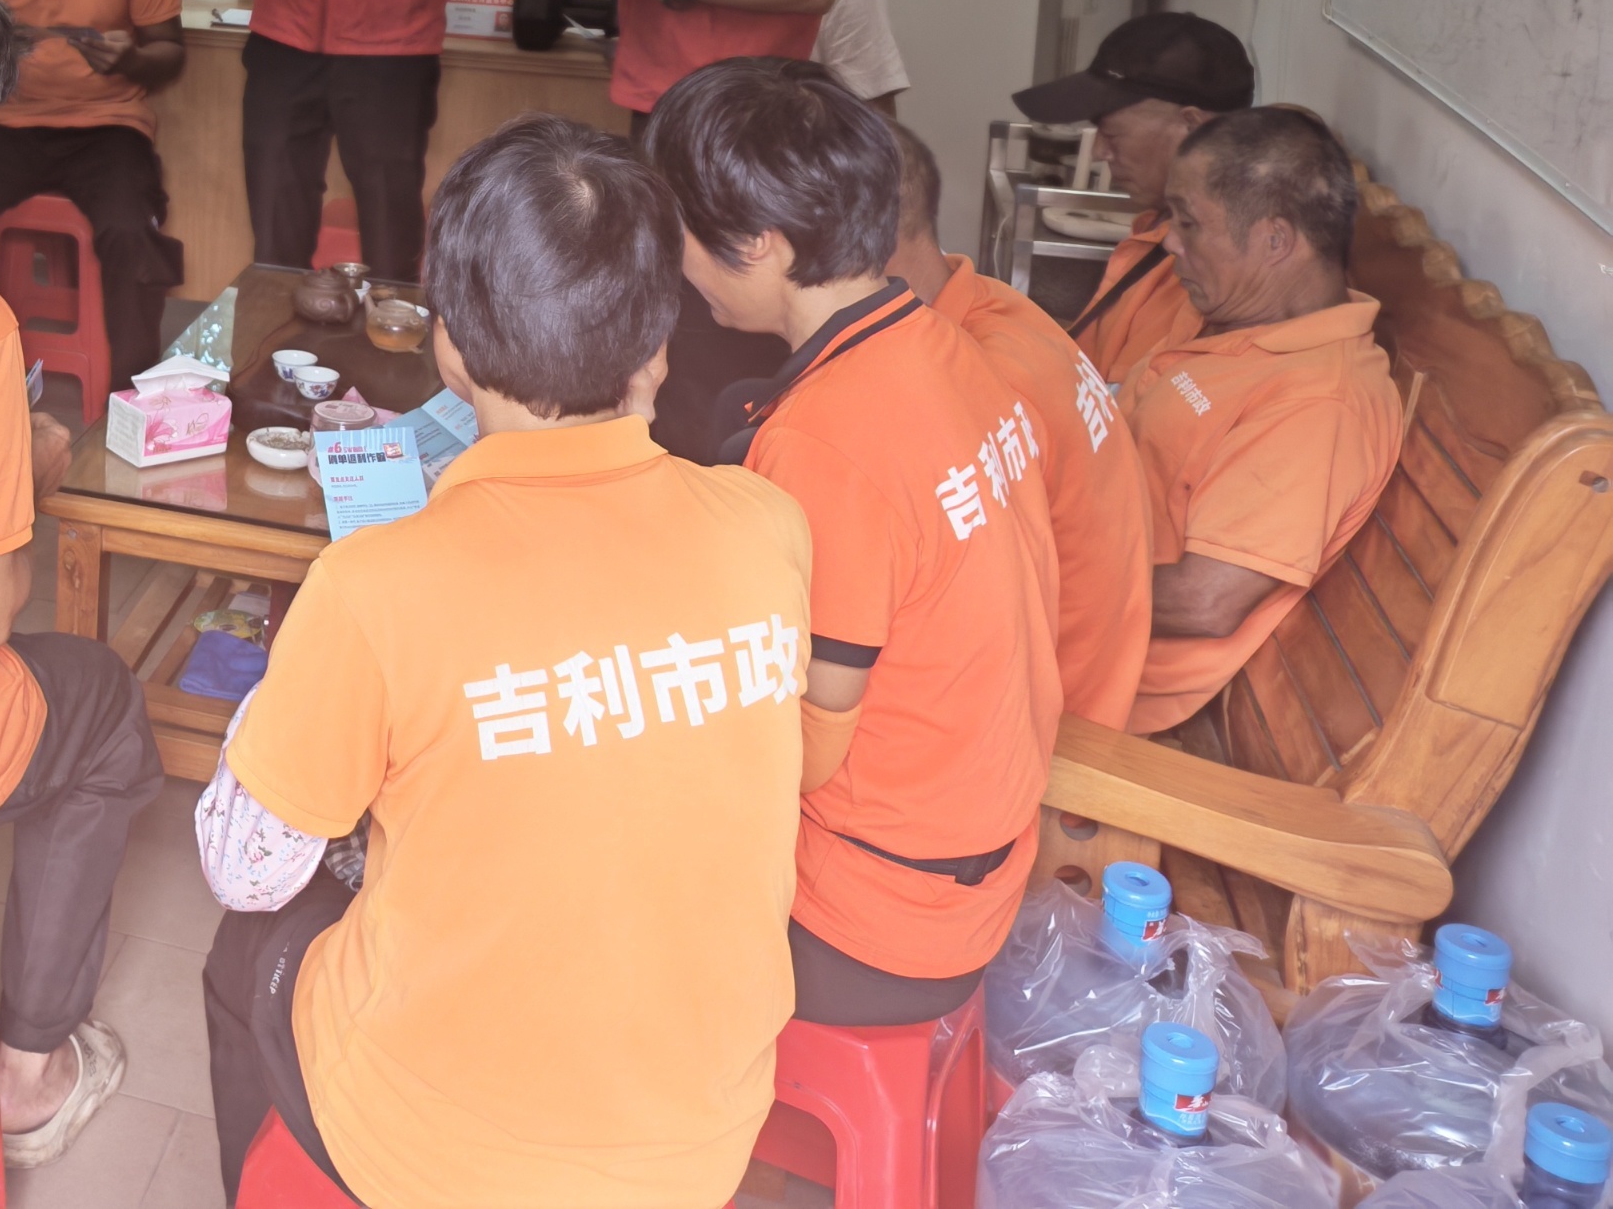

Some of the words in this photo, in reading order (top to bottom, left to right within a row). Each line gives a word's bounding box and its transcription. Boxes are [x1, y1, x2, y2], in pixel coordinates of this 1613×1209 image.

[1075, 350, 1118, 454] 吉利
[1171, 371, 1212, 417] 吉利市政
[463, 614, 799, 761] 吉利市政
